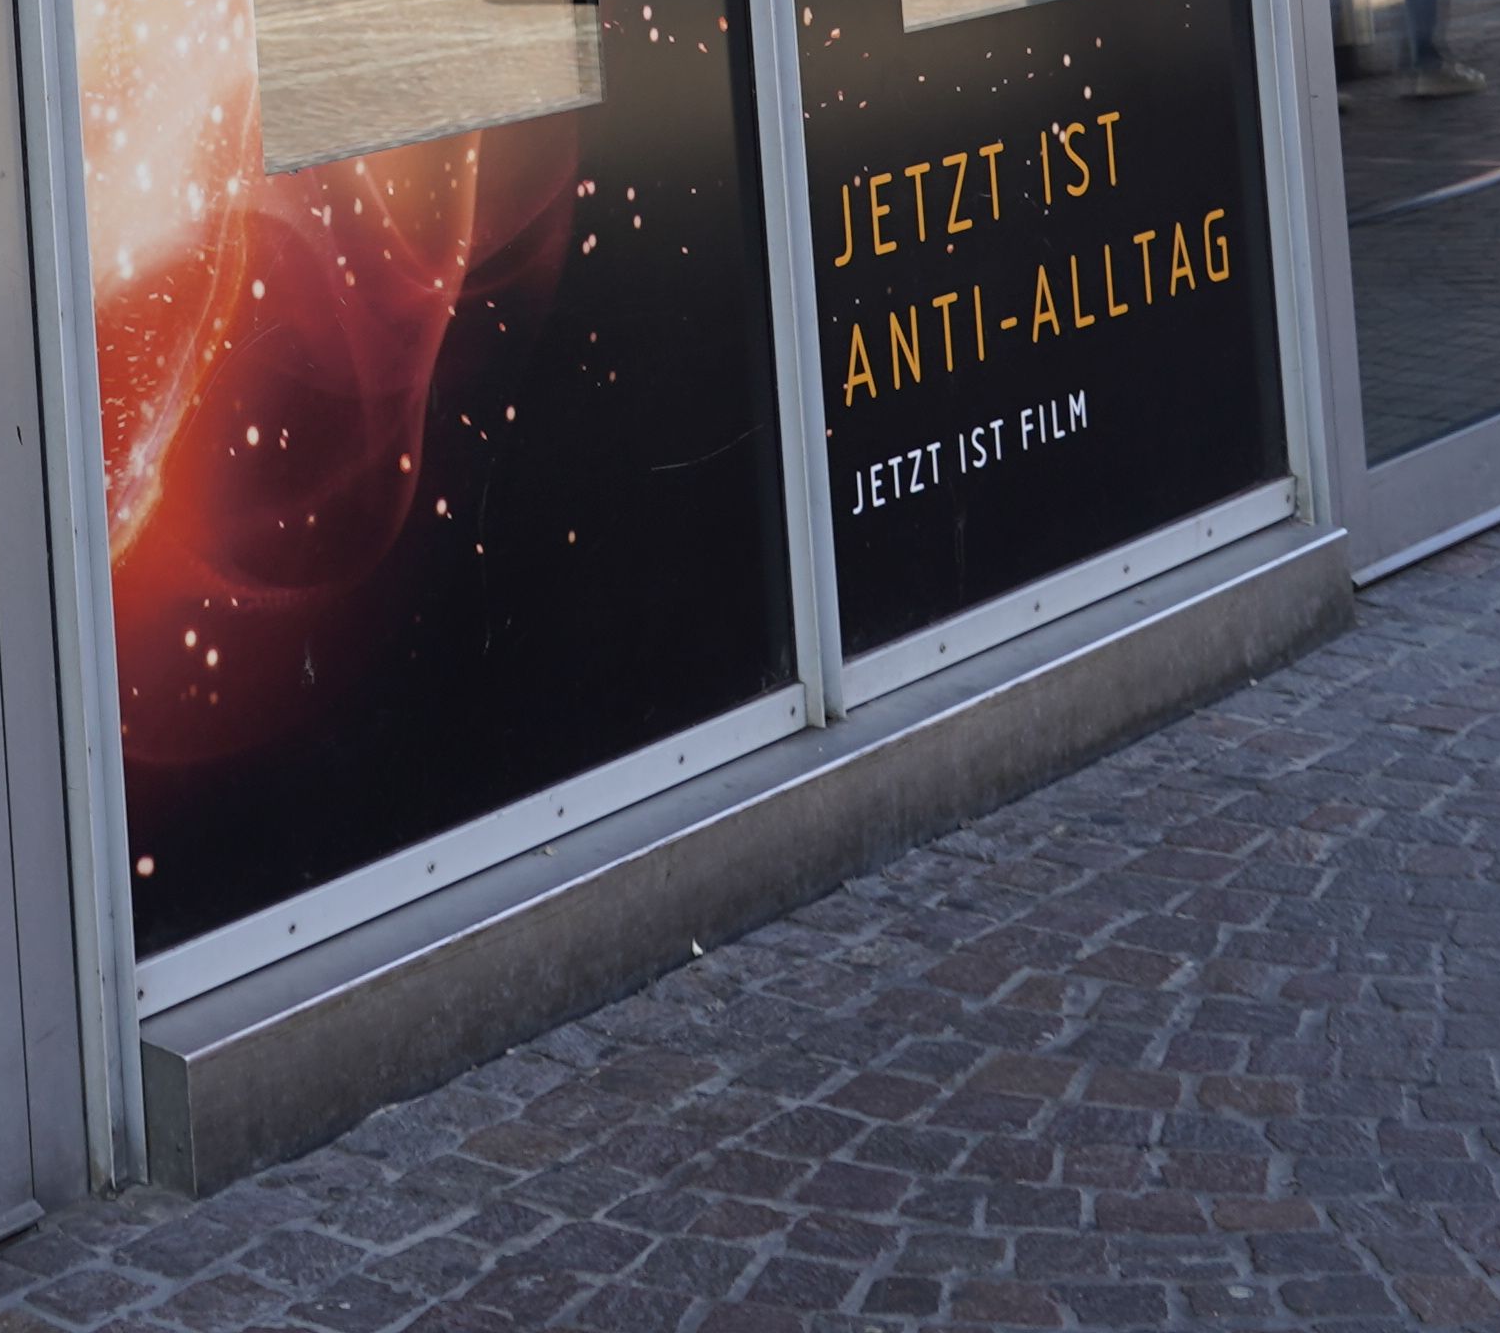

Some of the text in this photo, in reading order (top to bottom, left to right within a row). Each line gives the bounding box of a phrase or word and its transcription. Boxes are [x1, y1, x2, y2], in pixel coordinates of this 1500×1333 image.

[834, 111, 1120, 267] JETZT IST
[845, 209, 1230, 408] ANTI-ALLTAG
[852, 389, 1088, 516] JETZT IST FILM
